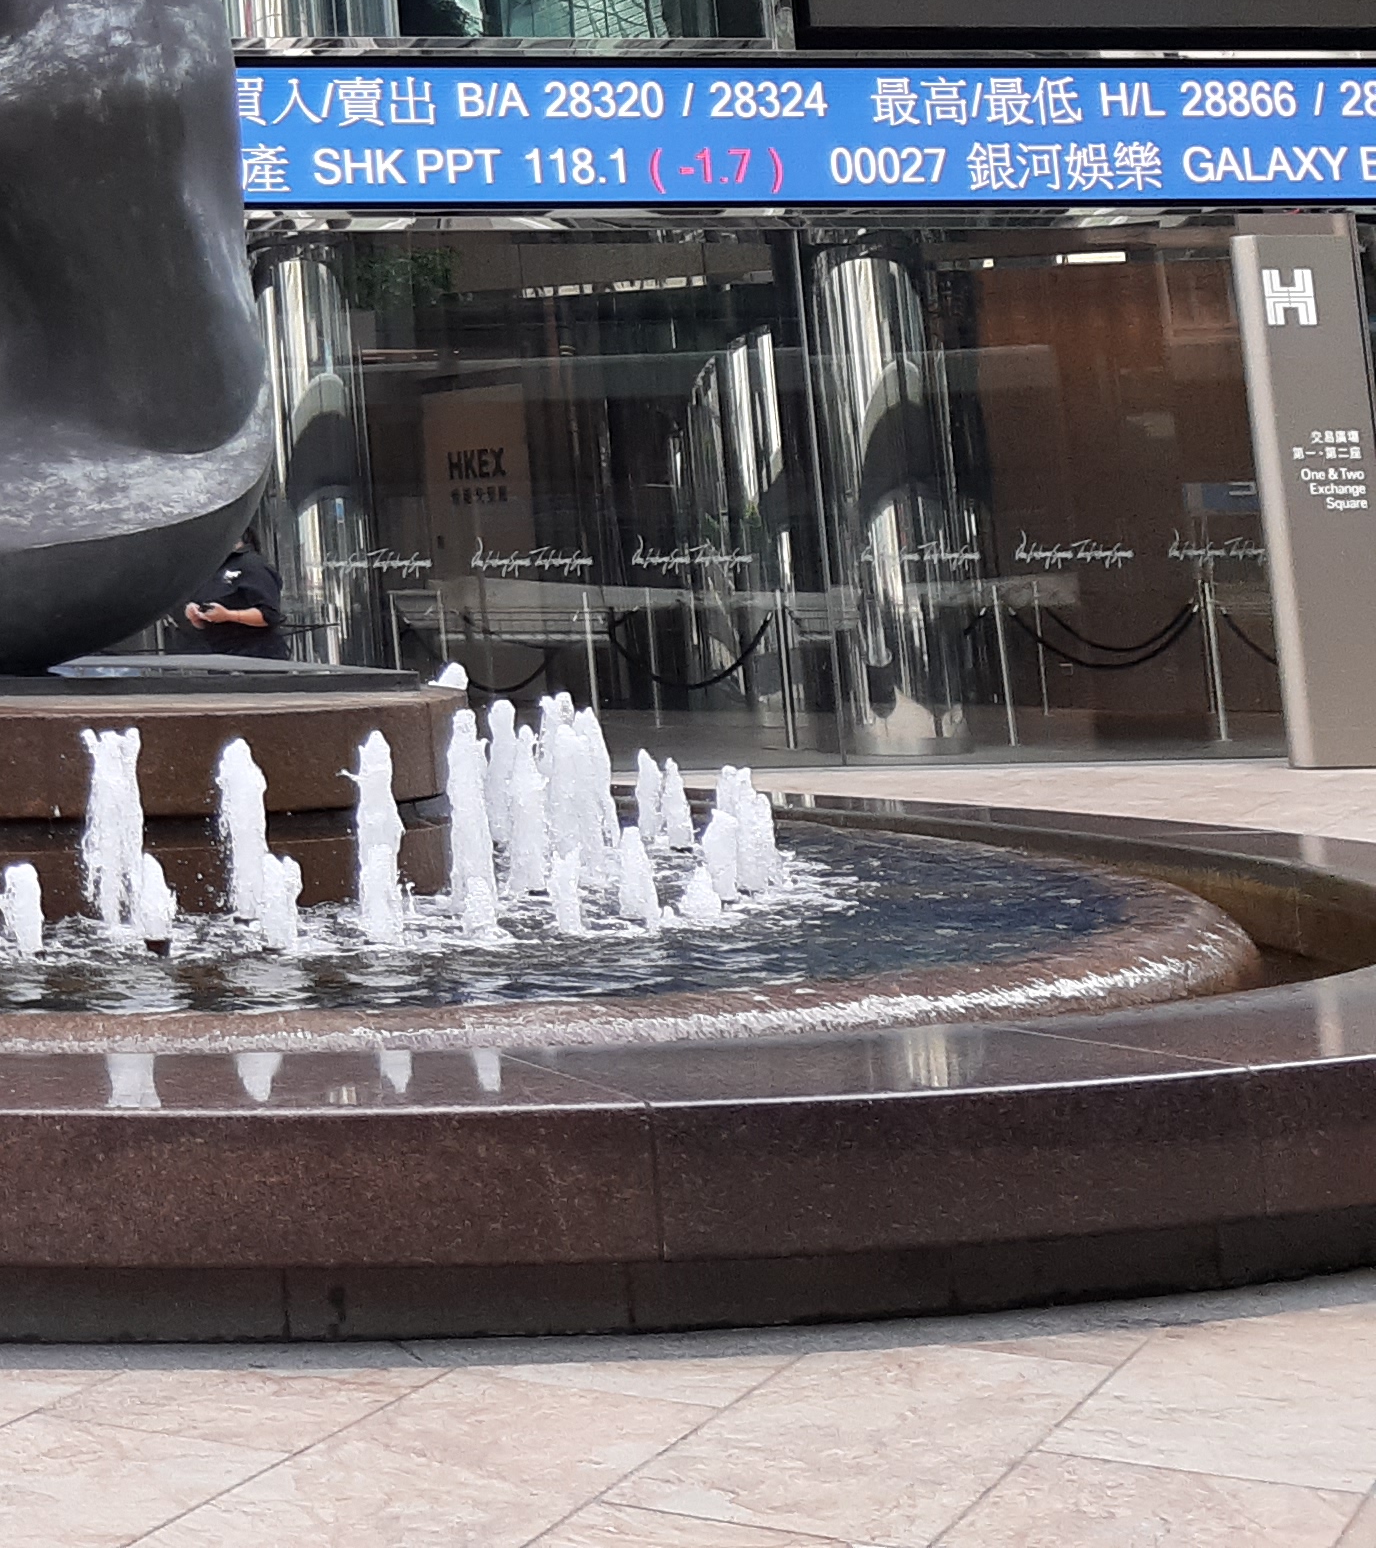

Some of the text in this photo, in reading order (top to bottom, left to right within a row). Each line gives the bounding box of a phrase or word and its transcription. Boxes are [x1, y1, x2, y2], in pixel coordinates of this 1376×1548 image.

[544, 81, 664, 118] 28320
[709, 81, 828, 118] 28324
[1180, 80, 1297, 117] 28866
[241, 143, 290, 192] 產
[313, 148, 407, 185] SHK
[416, 148, 501, 184] PPT
[525, 147, 626, 185] 118.1
[830, 147, 946, 184] 00027
[1183, 146, 1348, 183] GALAXY
[448, 447, 507, 480] HKEX
[1300, 468, 1365, 481] One & Two
[1309, 482, 1367, 497] Exchange
[1325, 497, 1369, 512] Square
